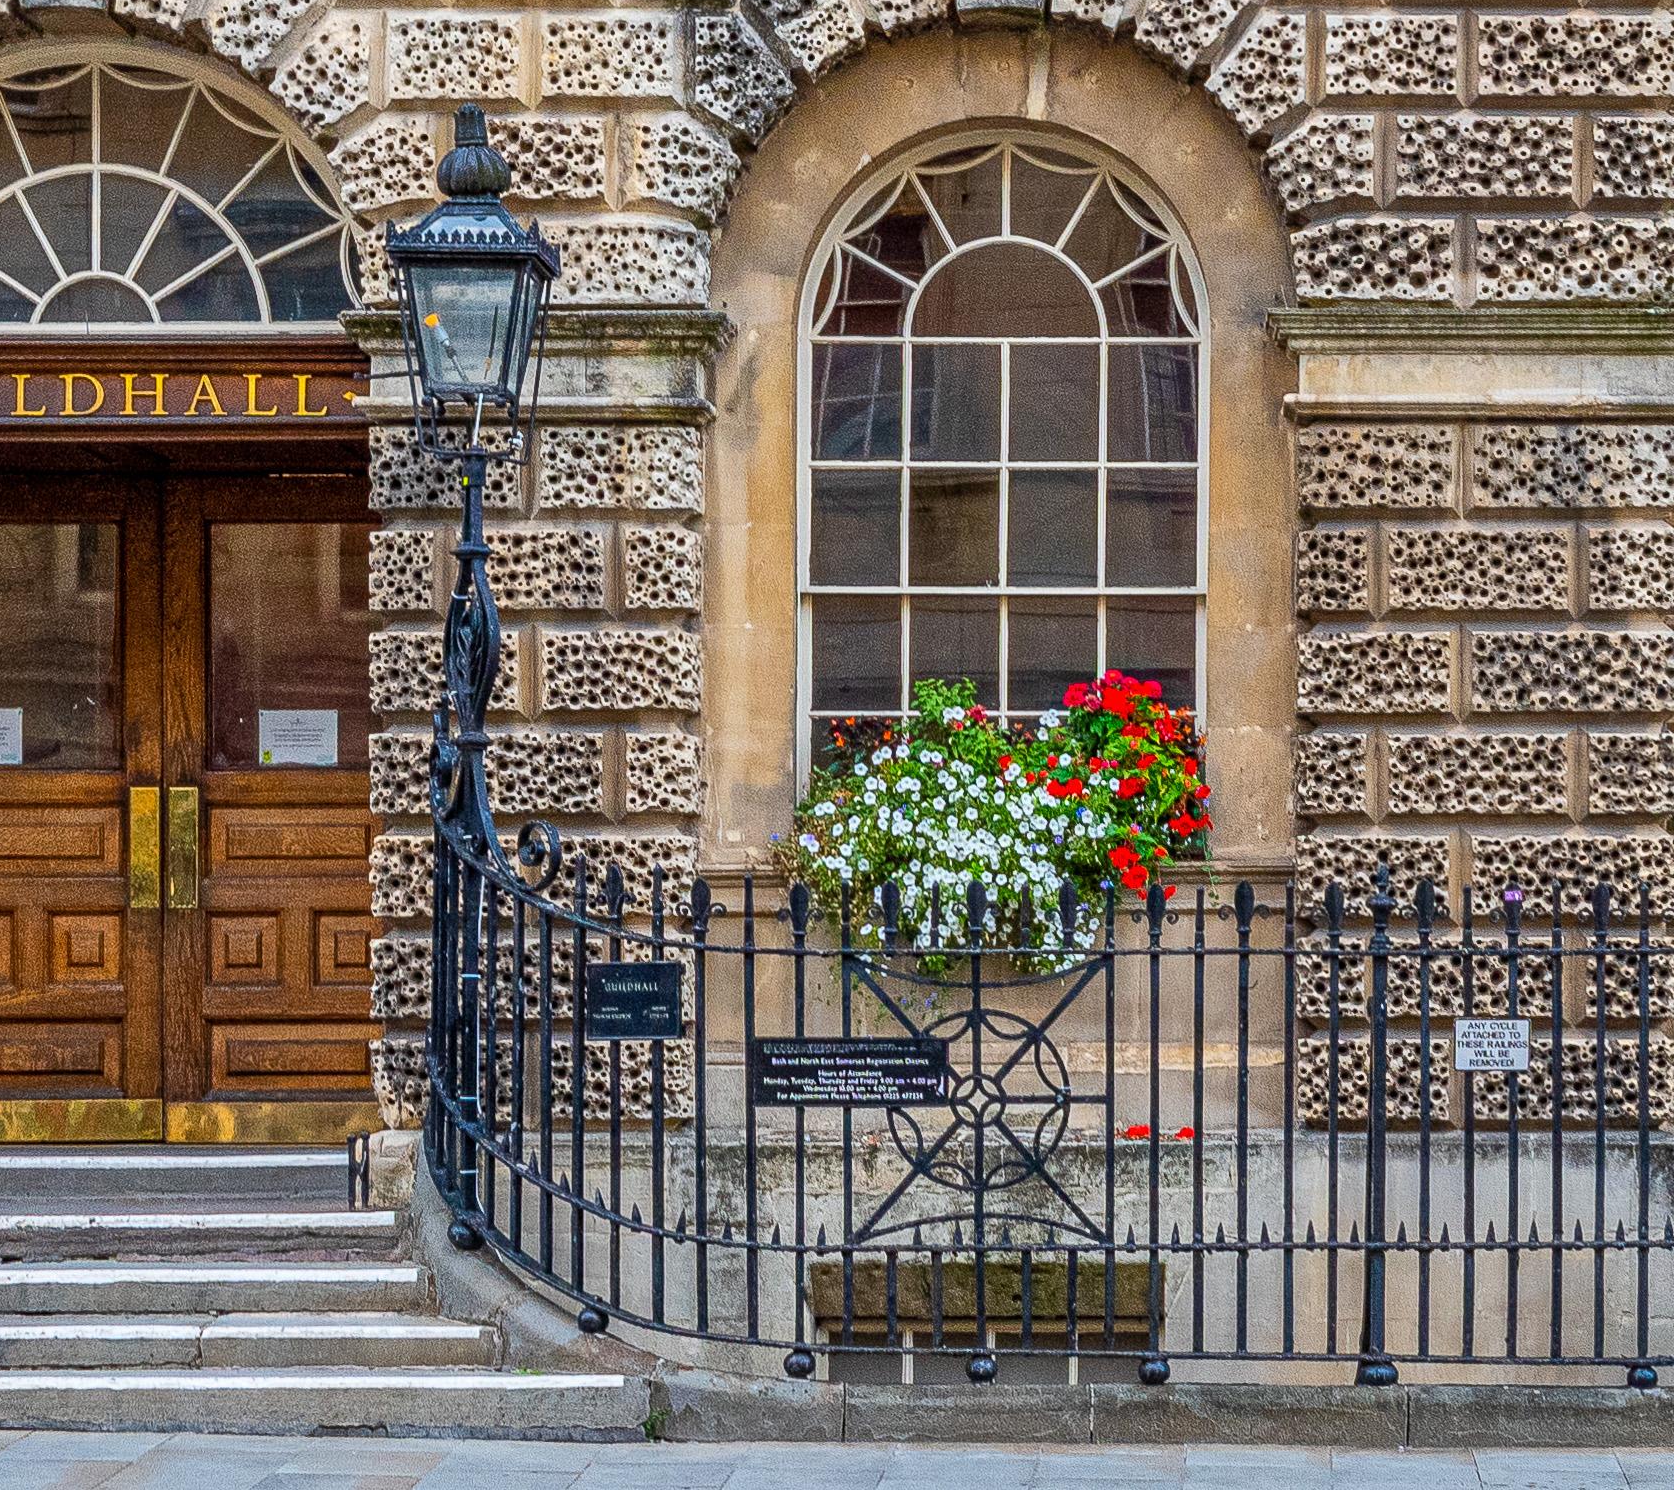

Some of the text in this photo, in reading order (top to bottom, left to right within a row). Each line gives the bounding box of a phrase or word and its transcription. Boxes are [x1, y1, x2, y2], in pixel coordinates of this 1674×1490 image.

[604, 982, 658, 992] GUILDHALL
[1467, 1022, 1517, 1030] ANY CYCLE
[1461, 1031, 1521, 1039] ATTACHED TO
[1457, 1040, 1528, 1048] THESE RAILINGS
[1474, 1050, 1510, 1058] WILL BE
[771, 1057, 929, 1065] Bath and North East Somerset Registration District
[817, 1069, 882, 1077] Hours of Attendance
[848, 1077, 858, 1085] and
[860, 1077, 878, 1085] Friday
[803, 1085, 837, 1093] Wednesday
[777, 1092, 788, 1100] For
[790, 1092, 829, 1100] Appointment
[830, 1092, 849, 1100] Please
[852, 1092, 881, 1100] Telephone
